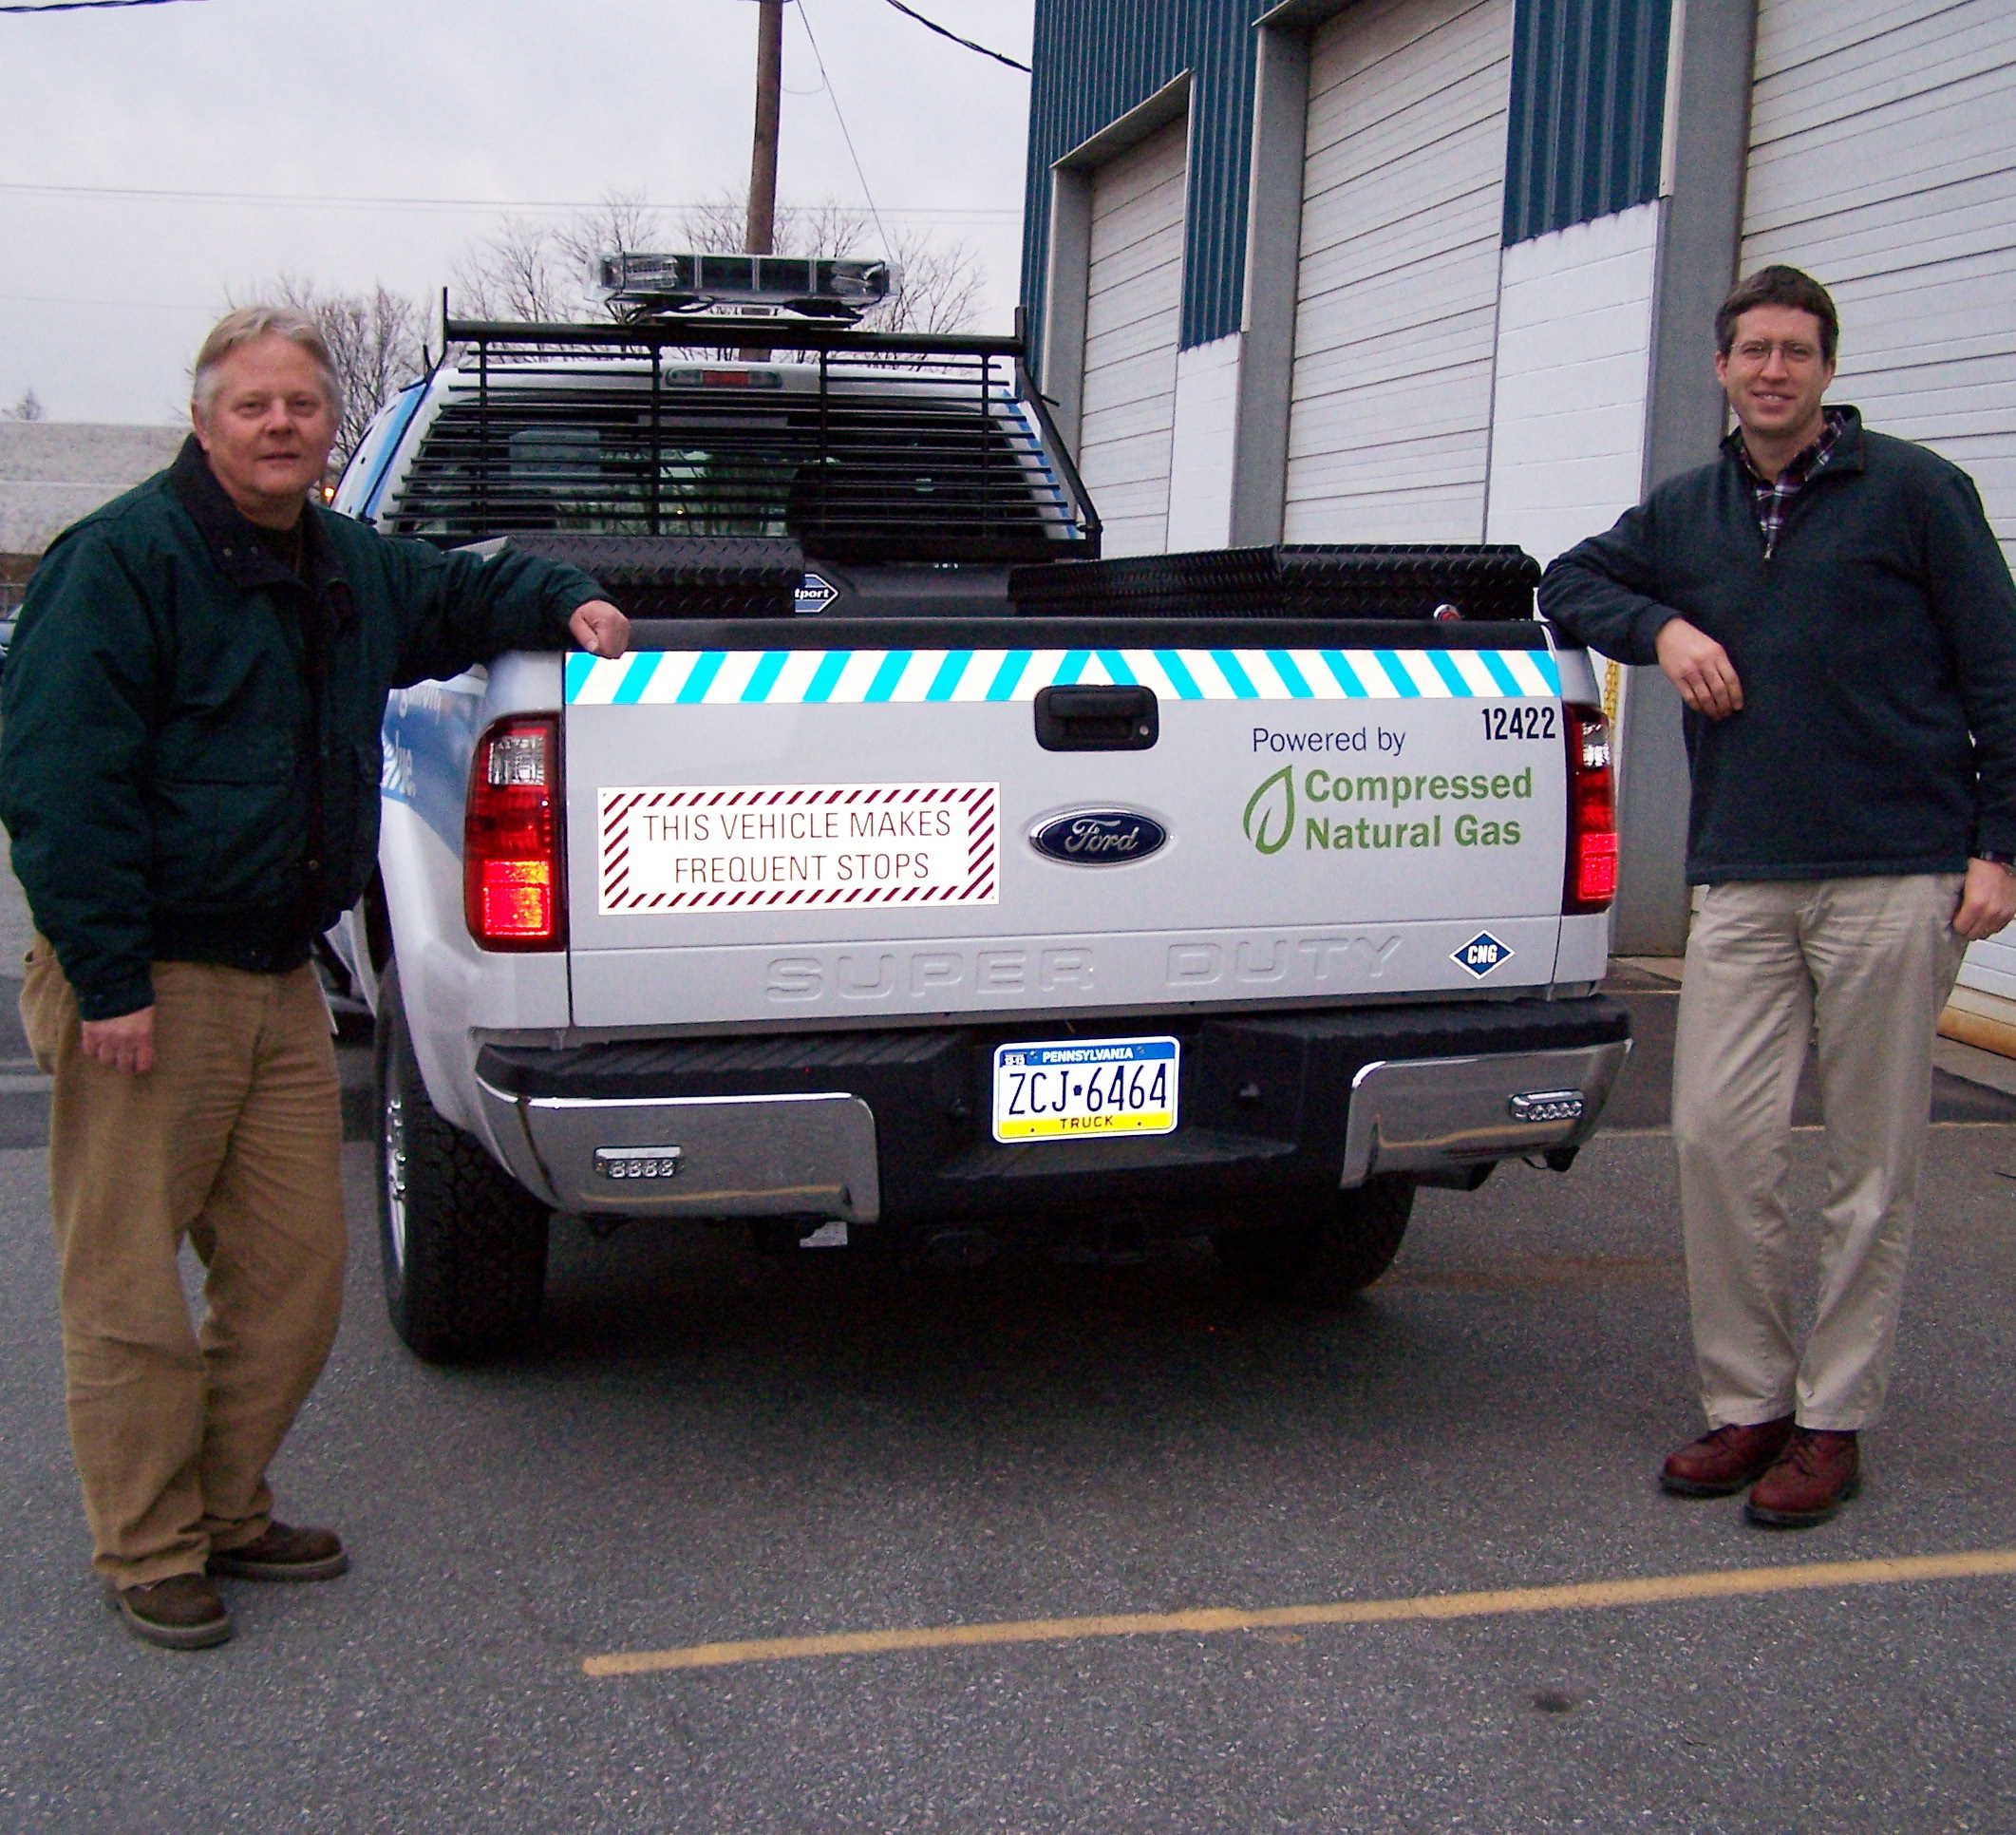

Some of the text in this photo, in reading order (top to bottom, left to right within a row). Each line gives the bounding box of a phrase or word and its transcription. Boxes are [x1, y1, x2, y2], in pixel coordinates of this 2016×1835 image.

[1481, 706, 1555, 740] 12422
[1253, 727, 1406, 757] Powered by
[1305, 766, 1533, 808] Compressed
[643, 809, 951, 841] THIS VEHICLE MAKES
[1064, 818, 1140, 853] Ford
[1305, 813, 1521, 850] Natural Gas
[675, 852, 930, 883] FREQUENT STOPS
[765, 935, 1404, 1002] SUPER DUTY
[1467, 944, 1498, 964] CNG
[1042, 1047, 1134, 1064] PENNSYLVANIA
[1060, 1115, 1114, 1130] TRUCK
